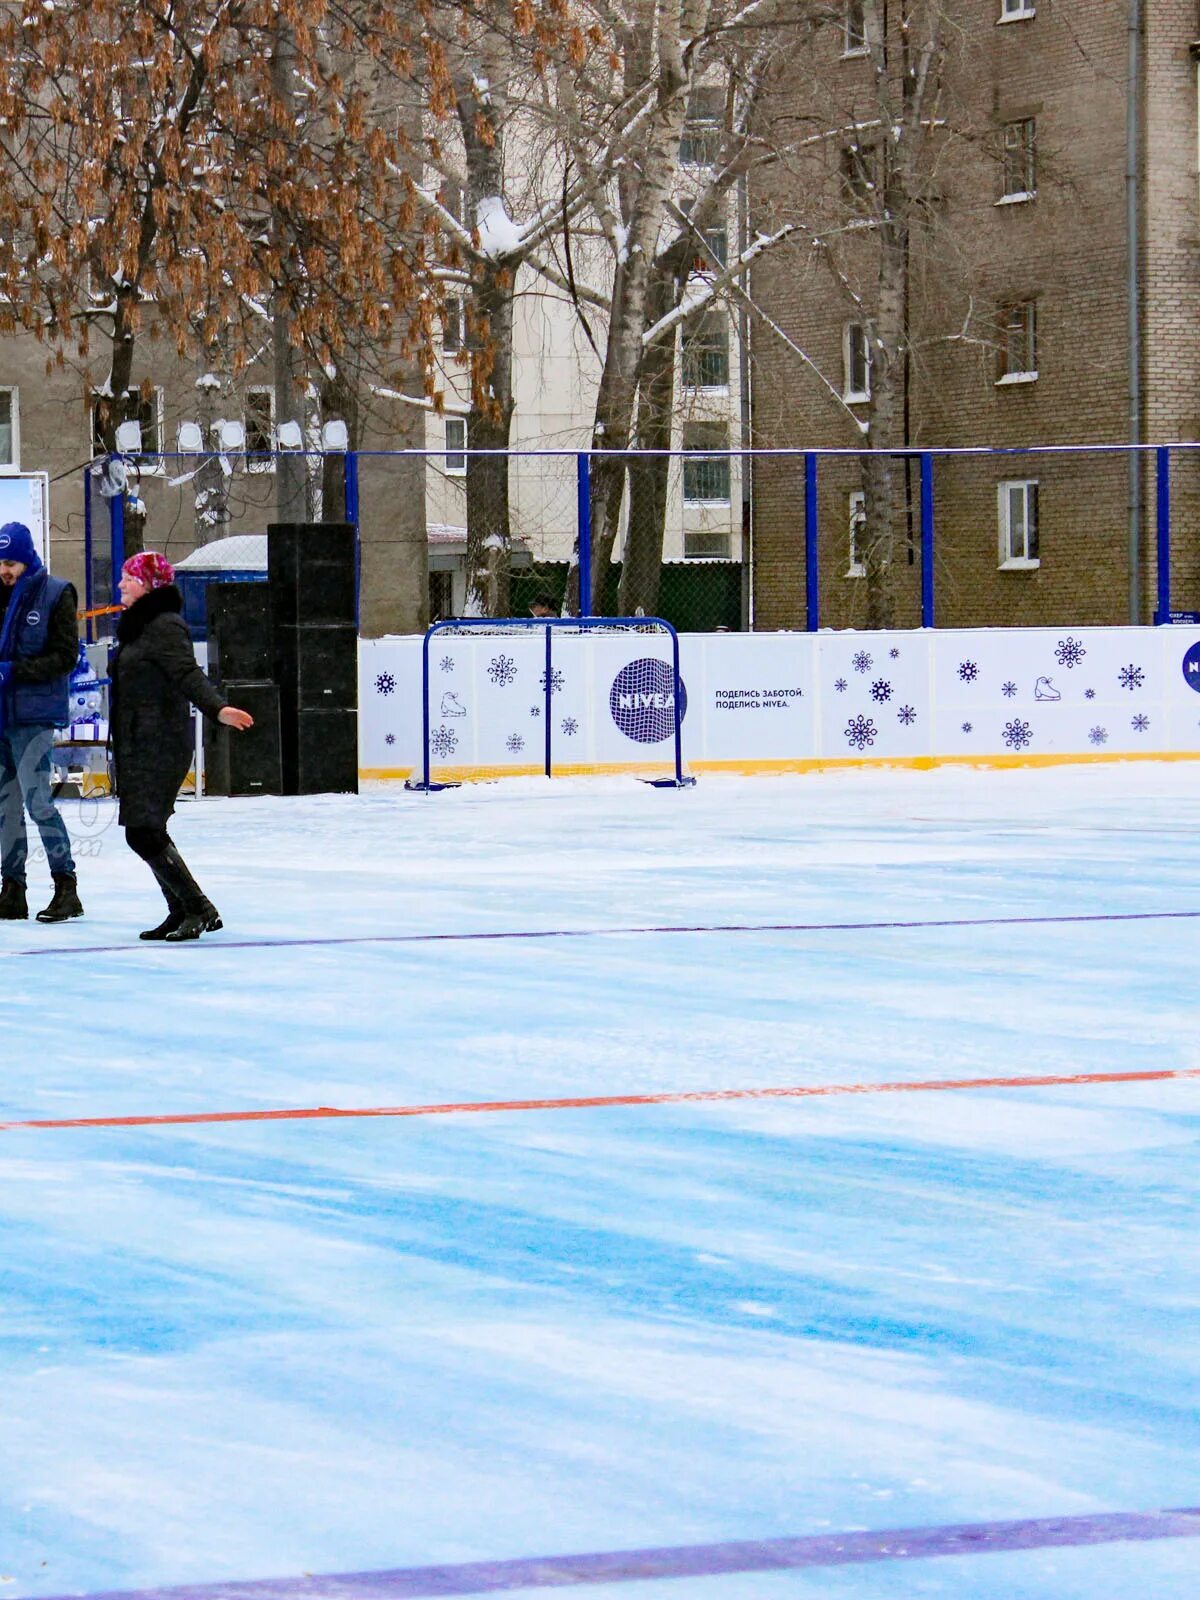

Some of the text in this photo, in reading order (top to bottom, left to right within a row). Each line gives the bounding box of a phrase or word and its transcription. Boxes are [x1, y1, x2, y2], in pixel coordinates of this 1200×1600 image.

[715, 688, 804, 699] ПОДЕЛИСЬ ЗАБОТОЙ.
[715, 701, 790, 710] ПОДЕЛИСЬ NIVEA.
